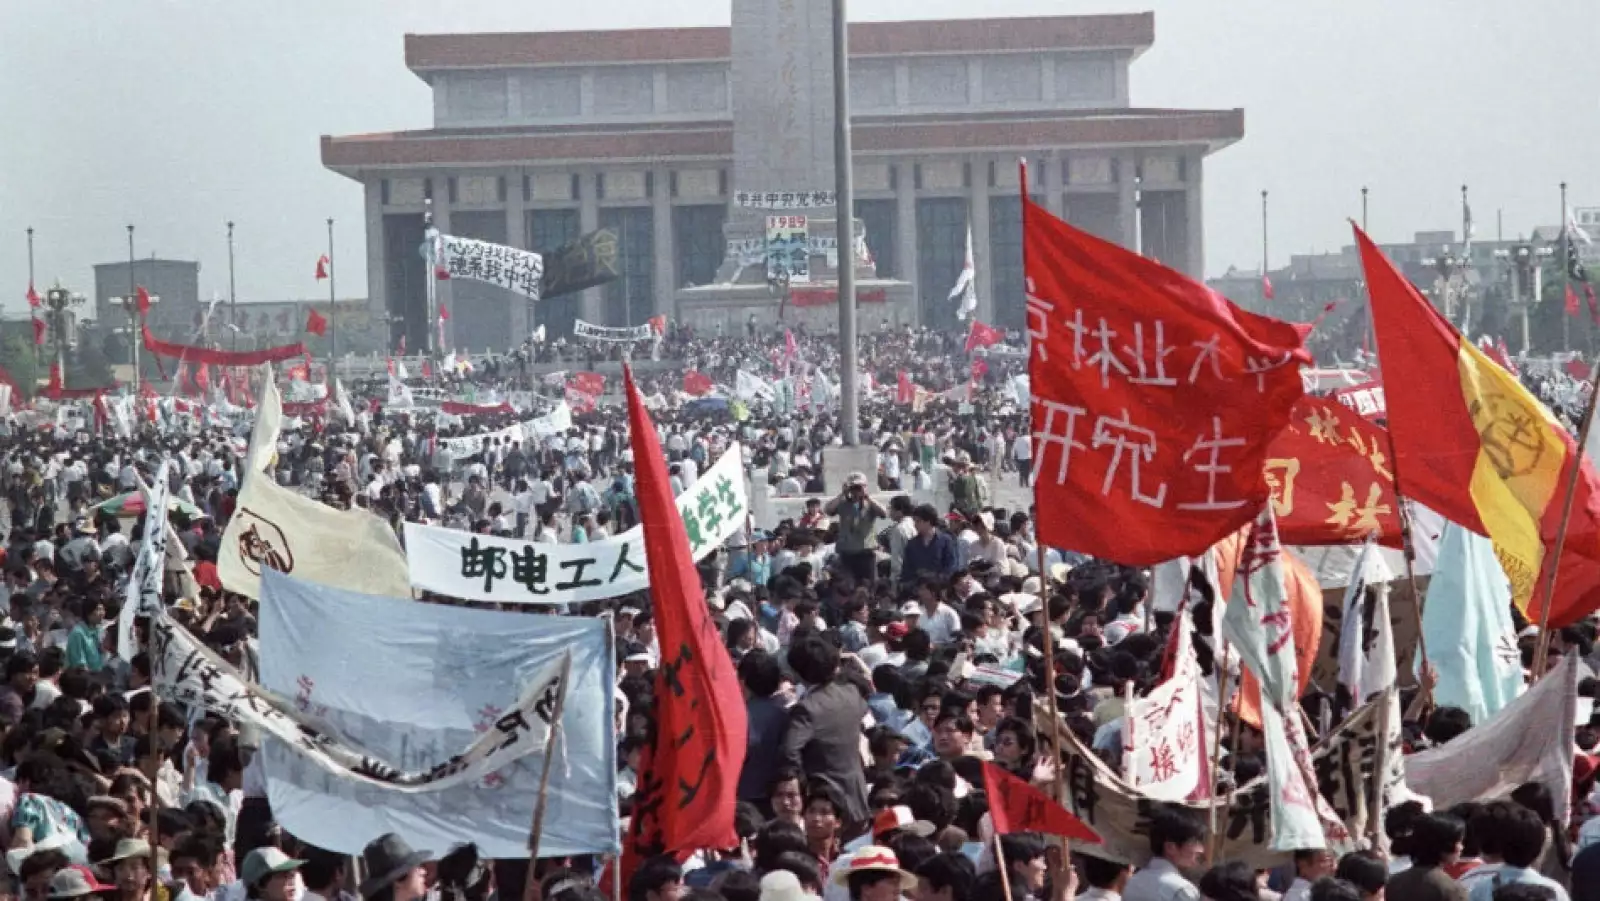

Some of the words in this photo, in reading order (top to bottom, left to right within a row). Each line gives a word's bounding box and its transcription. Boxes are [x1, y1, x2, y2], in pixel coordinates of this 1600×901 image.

[770, 216, 806, 229] 1989
[460, 536, 644, 595] 邮电工人
